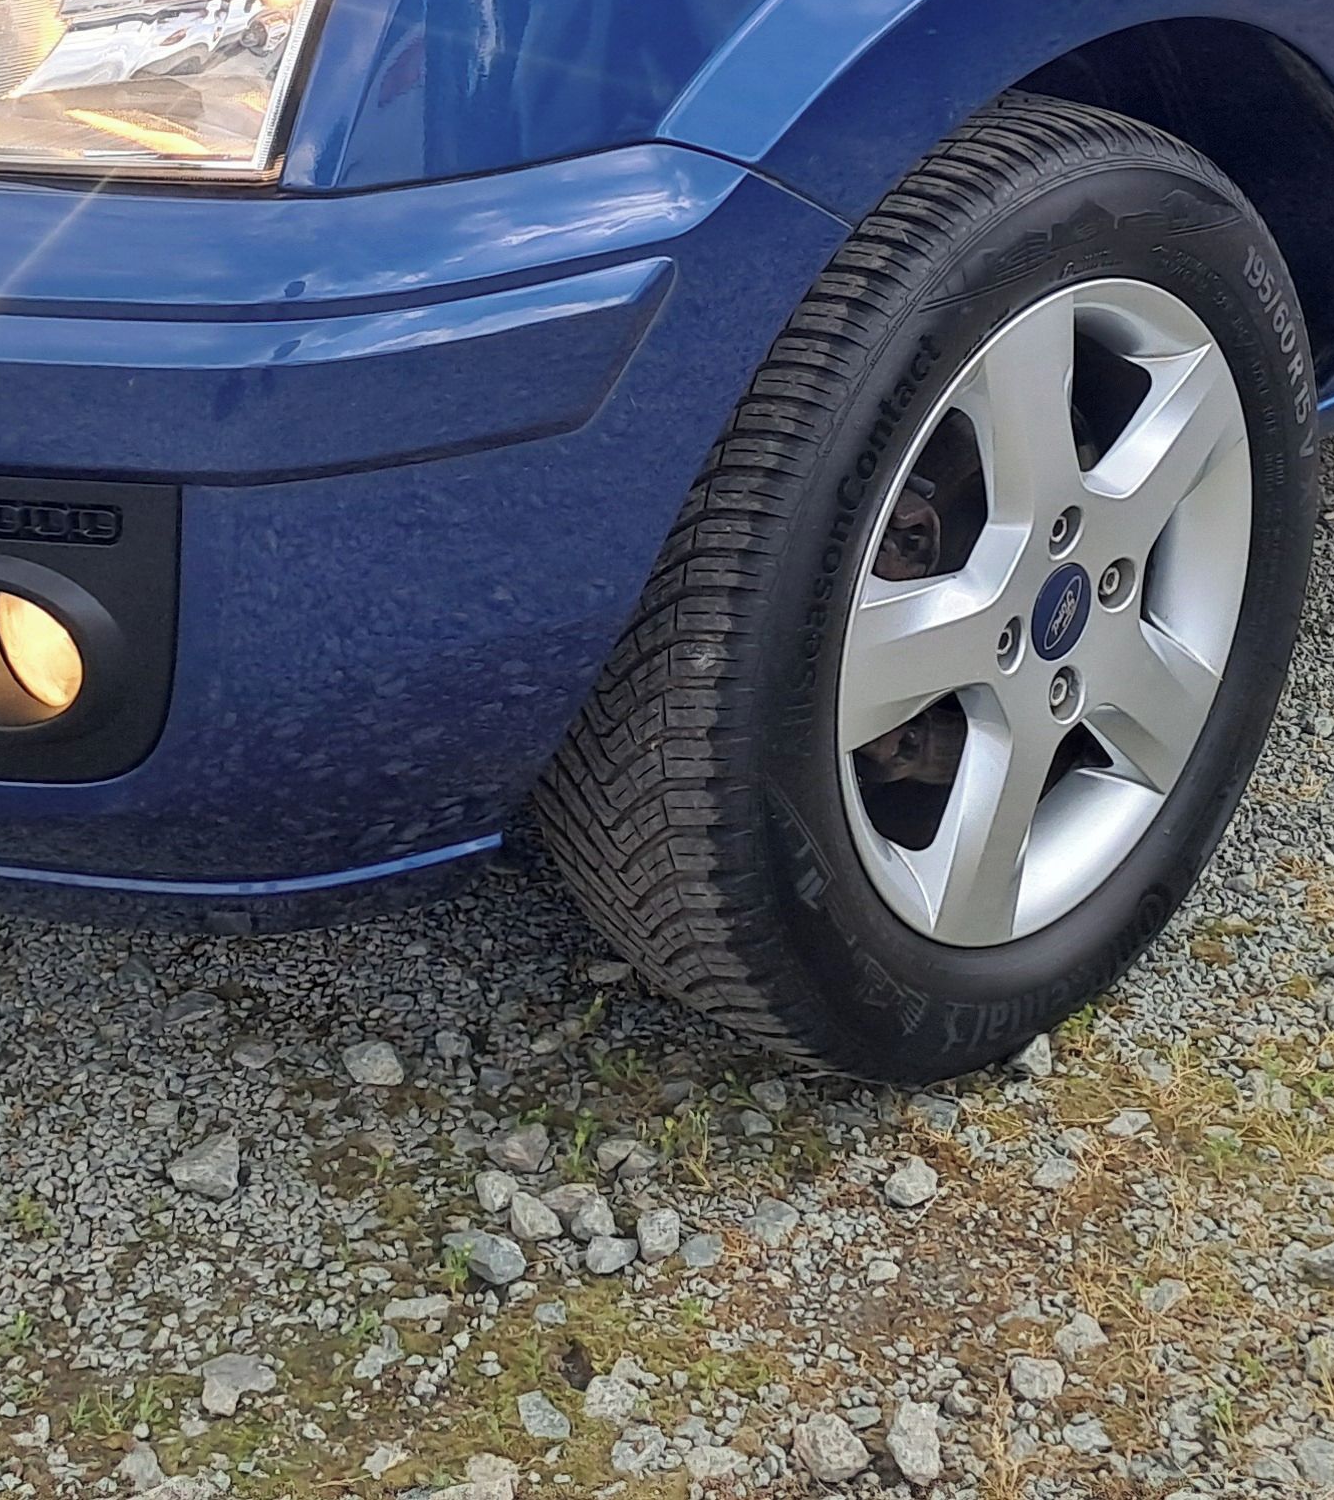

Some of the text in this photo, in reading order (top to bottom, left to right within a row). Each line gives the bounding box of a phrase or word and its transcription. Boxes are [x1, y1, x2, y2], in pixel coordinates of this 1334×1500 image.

[1242, 246, 1297, 354] 195/60
[1286, 353, 1305, 382] R
[1293, 384, 1313, 425] 15
